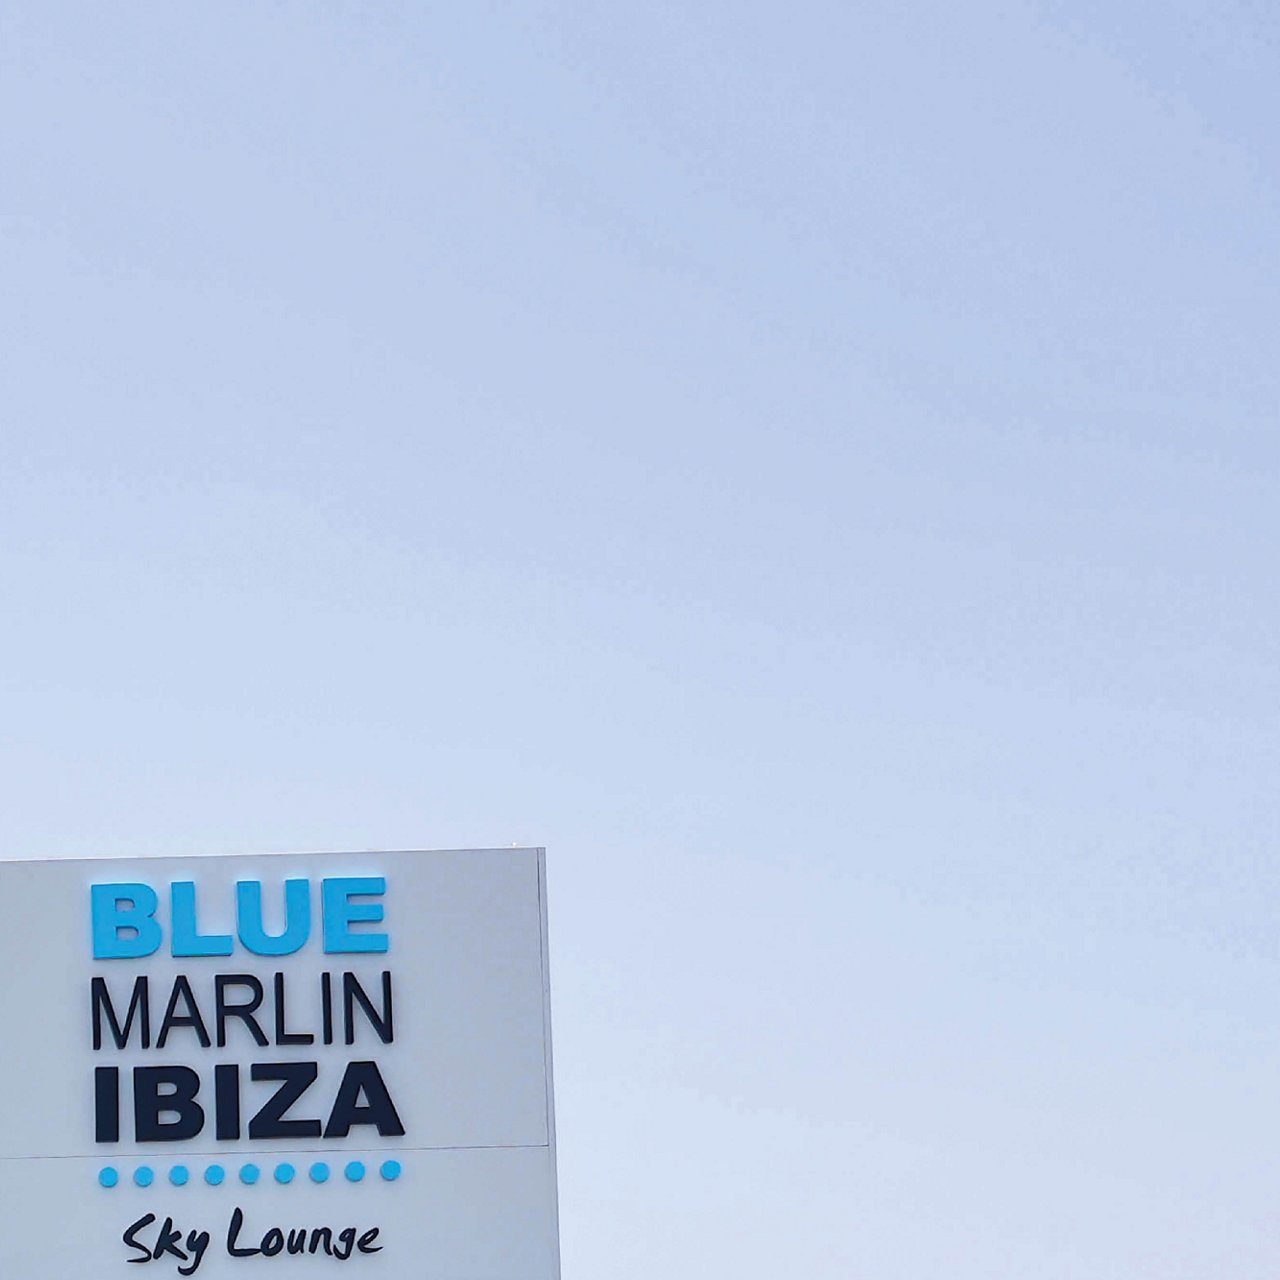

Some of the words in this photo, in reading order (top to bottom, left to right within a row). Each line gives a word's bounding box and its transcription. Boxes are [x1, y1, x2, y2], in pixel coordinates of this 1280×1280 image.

[89, 875, 391, 961] BLUE
[90, 970, 395, 1051] MARLIN
[93, 1060, 407, 1144] IBIZA
[121, 1212, 211, 1277] Sky
[226, 1206, 384, 1261] Lounge
